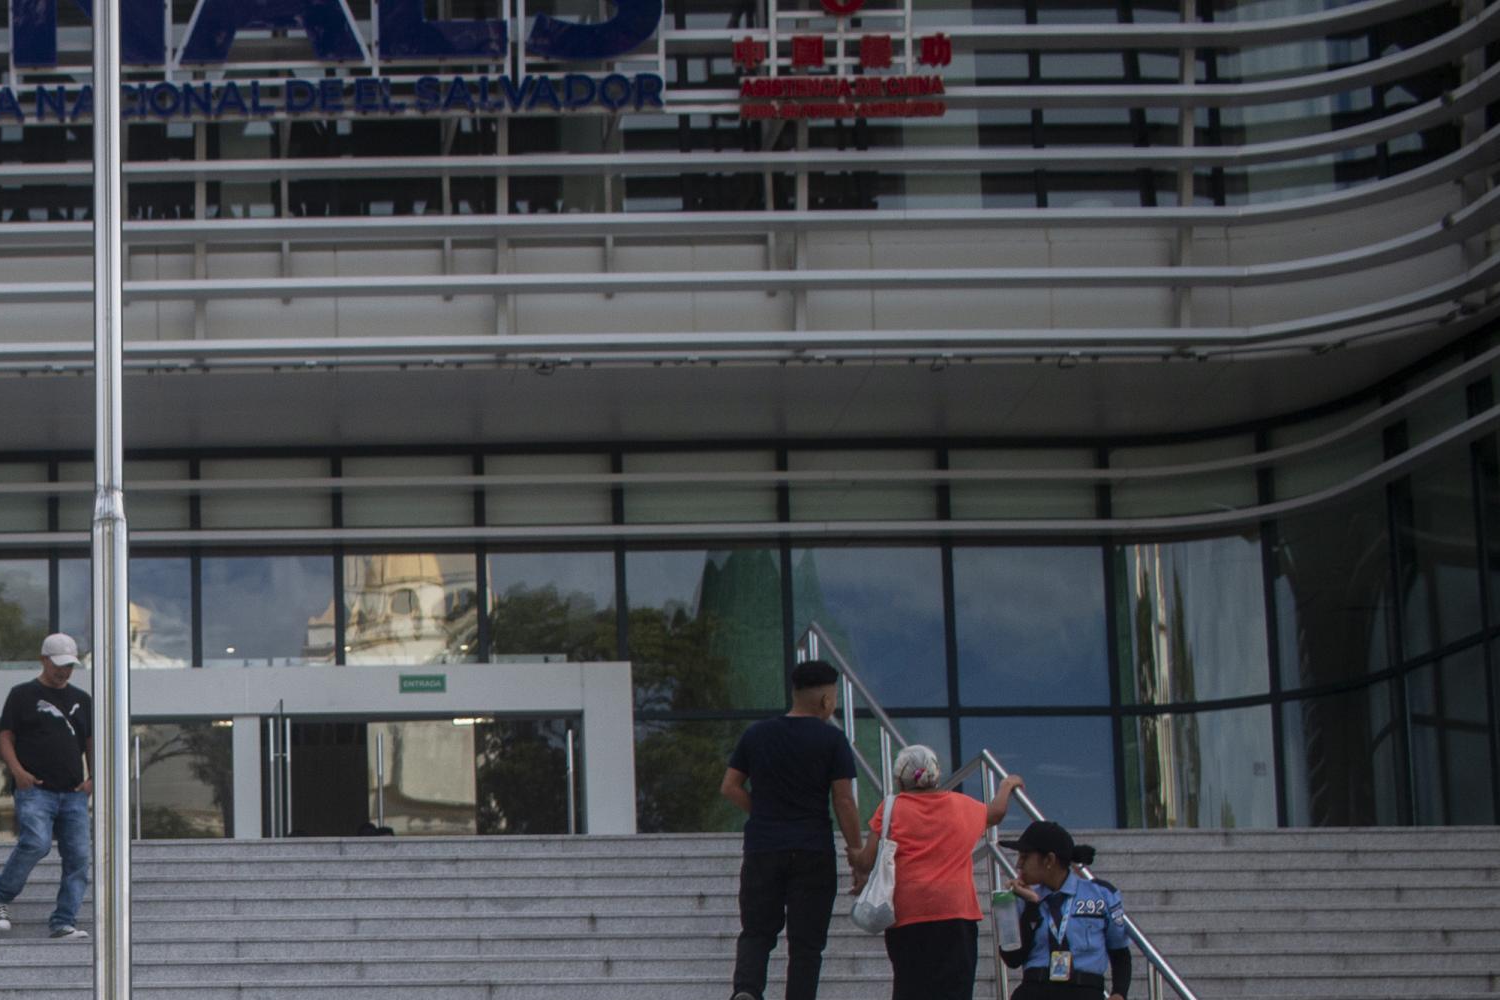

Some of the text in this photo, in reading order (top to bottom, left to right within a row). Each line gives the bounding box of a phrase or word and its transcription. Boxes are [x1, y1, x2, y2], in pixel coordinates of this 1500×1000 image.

[740, 75, 945, 97] ASISTENCIA DE CHINA
[36, 80, 275, 122] NACIONAL
[285, 78, 343, 113] DE
[355, 77, 407, 112] EL
[414, 72, 664, 112] SALVADOR
[403, 680, 442, 688] ENTRADA
[1076, 899, 1105, 914] 292
